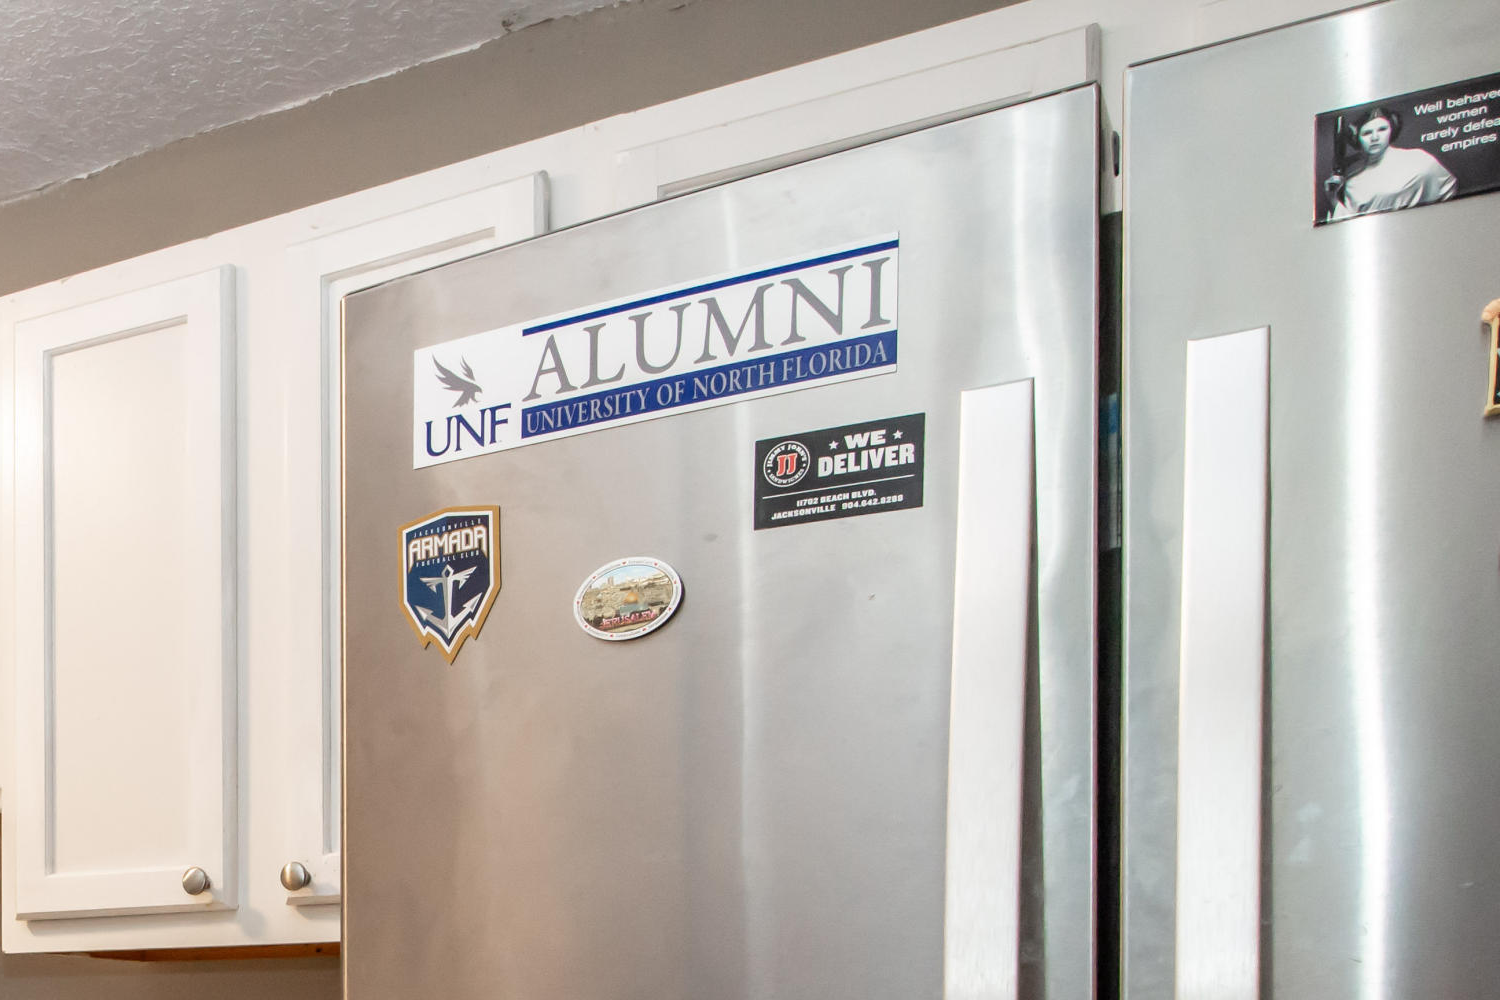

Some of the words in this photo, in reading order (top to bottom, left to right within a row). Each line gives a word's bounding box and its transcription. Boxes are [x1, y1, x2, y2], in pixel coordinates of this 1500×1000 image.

[1414, 100, 1443, 115] Well
[1436, 105, 1488, 124] women
[1420, 126, 1459, 143] rarely
[1441, 133, 1497, 152] empires
[522, 256, 892, 402] ALUMNI
[526, 388, 648, 434] UNIVERSITY
[656, 379, 686, 406] OF
[692, 360, 776, 400] NORTH
[781, 339, 888, 382] FLORIDA
[425, 402, 512, 457] UNF
[844, 429, 886, 449] WE
[776, 452, 798, 477] JJ
[818, 443, 915, 478] DELIVER
[820, 492, 850, 503] BEACH
[851, 489, 877, 499] BLVD.
[771, 504, 836, 520] JACKSONVILLE
[413, 518, 481, 538] JACKSONVILLE
[408, 524, 488, 574] ARMADA
[416, 555, 456, 568] FOOTBALL
[460, 549, 480, 559] CLUB
